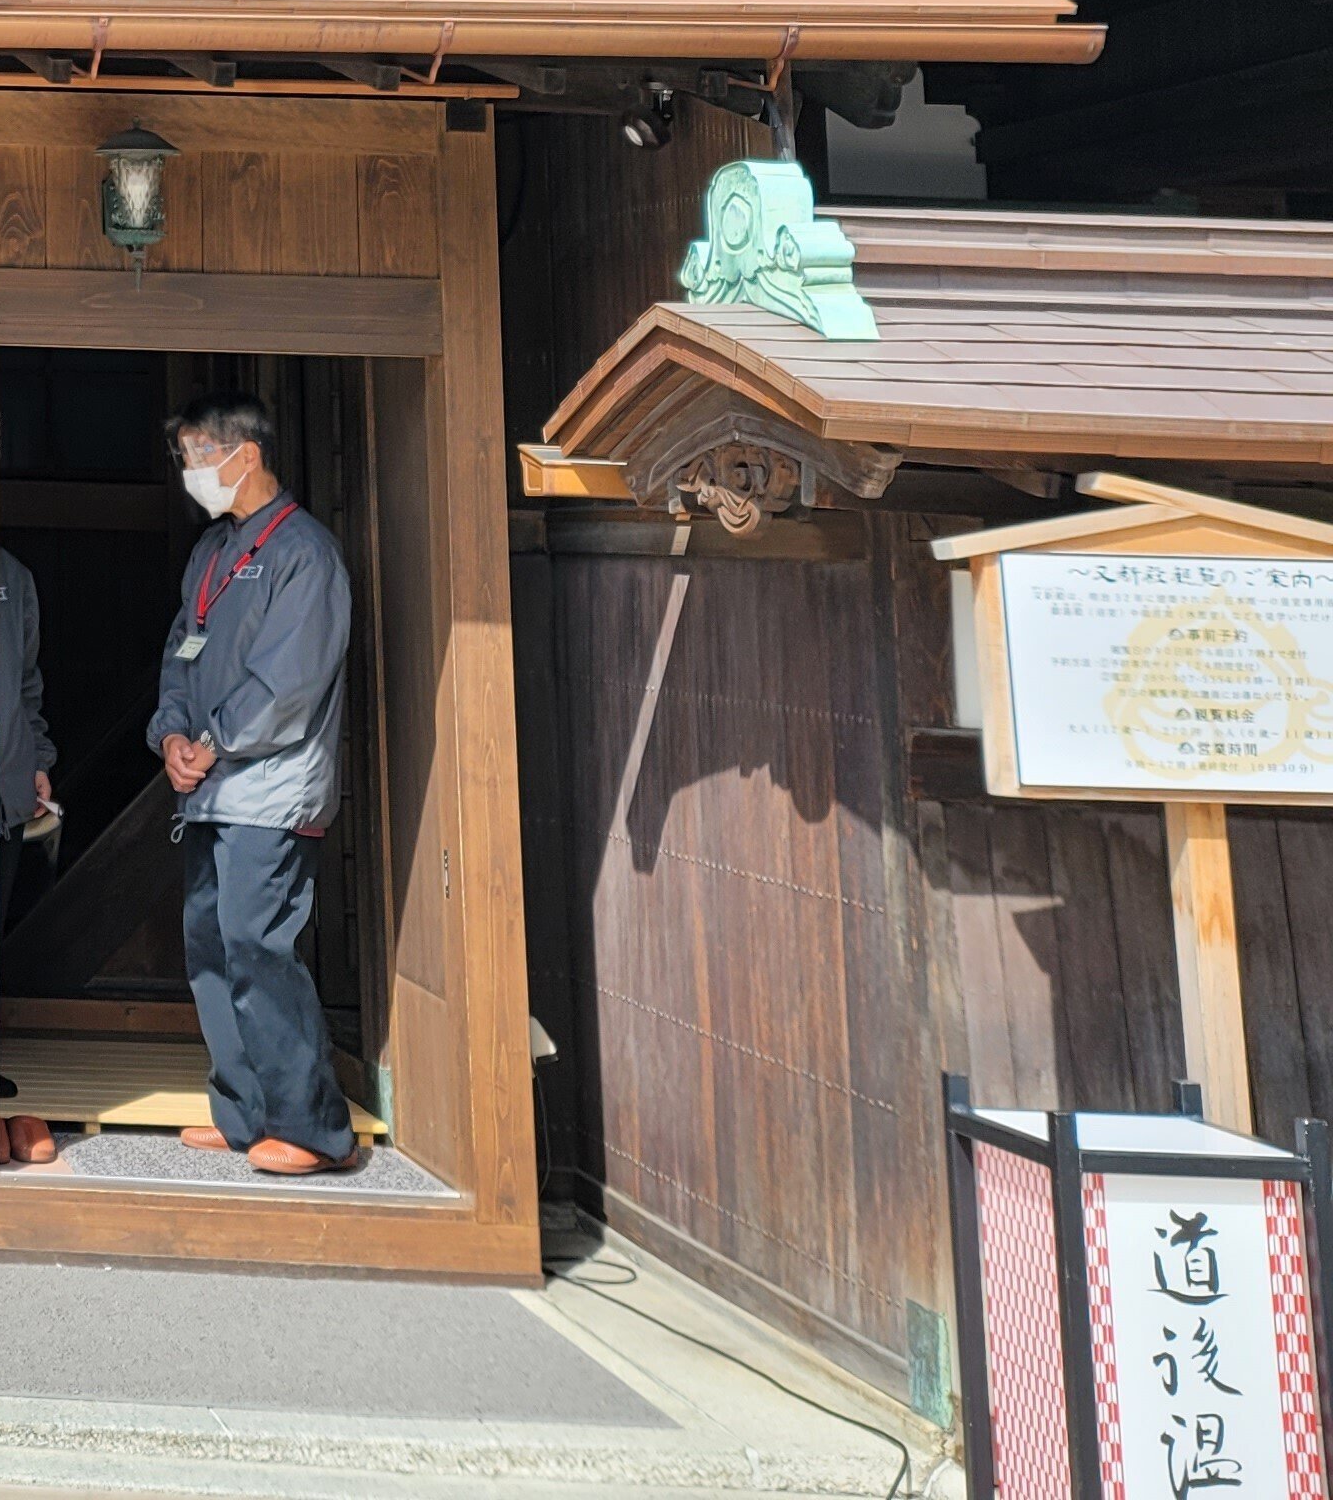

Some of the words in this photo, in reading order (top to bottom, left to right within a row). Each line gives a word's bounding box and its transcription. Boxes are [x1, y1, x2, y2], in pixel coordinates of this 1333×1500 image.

[1194, 708, 1255, 723] 観覧料金
[1197, 742, 1258, 757] 営業時間
[1147, 1209, 1243, 1500] 道後温
